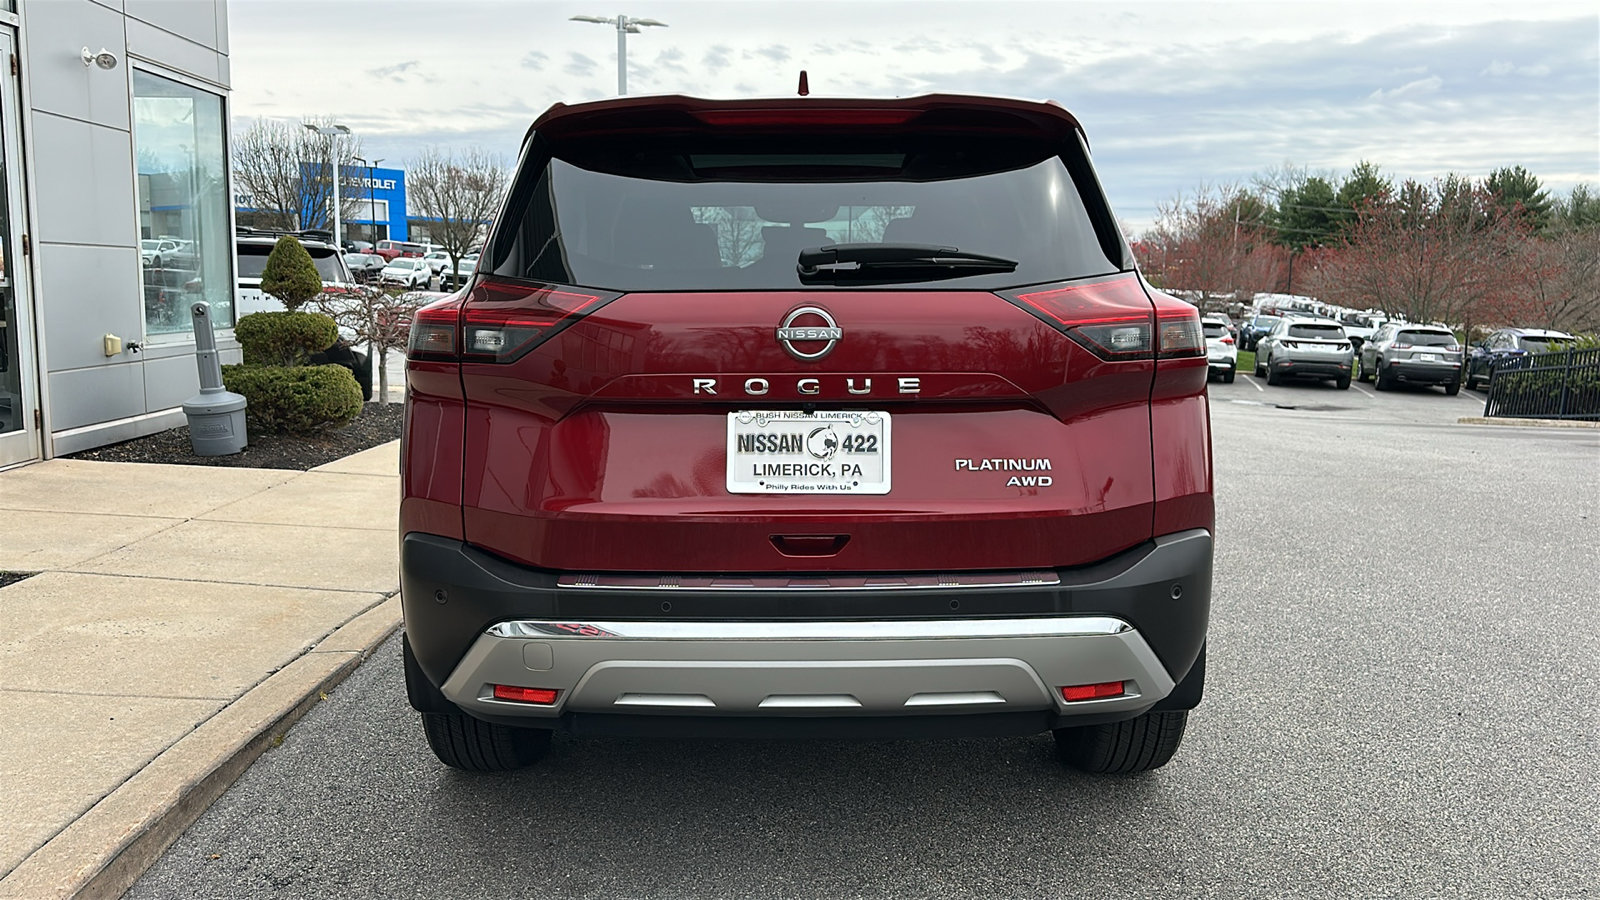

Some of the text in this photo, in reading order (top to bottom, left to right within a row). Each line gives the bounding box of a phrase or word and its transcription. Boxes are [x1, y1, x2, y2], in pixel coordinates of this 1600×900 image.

[338, 176, 397, 190] CHEVROLET
[778, 329, 842, 340] NISSAN
[692, 377, 921, 396] ROGUE
[755, 411, 863, 419] BUSH NISSAN LIMERICK
[737, 433, 878, 454] NISSAN 422
[752, 463, 863, 478] LIMERICK, PA
[954, 458, 1053, 471] PLATINUM
[765, 483, 789, 491] Philly
[1005, 475, 1054, 487] AWD
